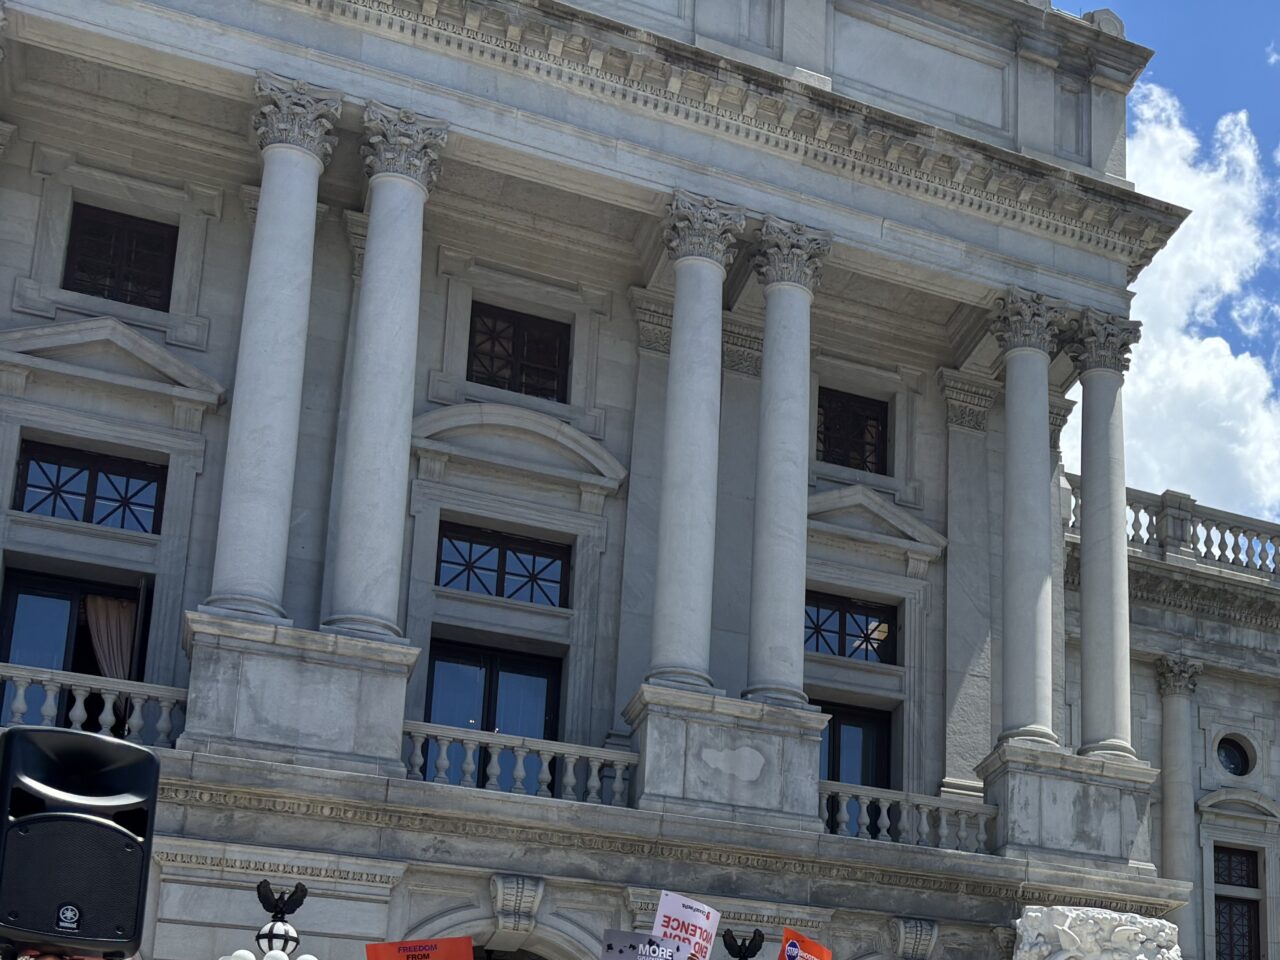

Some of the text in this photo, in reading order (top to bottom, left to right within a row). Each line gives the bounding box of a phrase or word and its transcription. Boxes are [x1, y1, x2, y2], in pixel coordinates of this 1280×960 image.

[661, 914, 712, 946] VIOLENCE
[398, 944, 438, 954] FREEDOM
[638, 943, 673, 960] MORE
[787, 946, 799, 957] STOP
[406, 953, 430, 960] FROM
